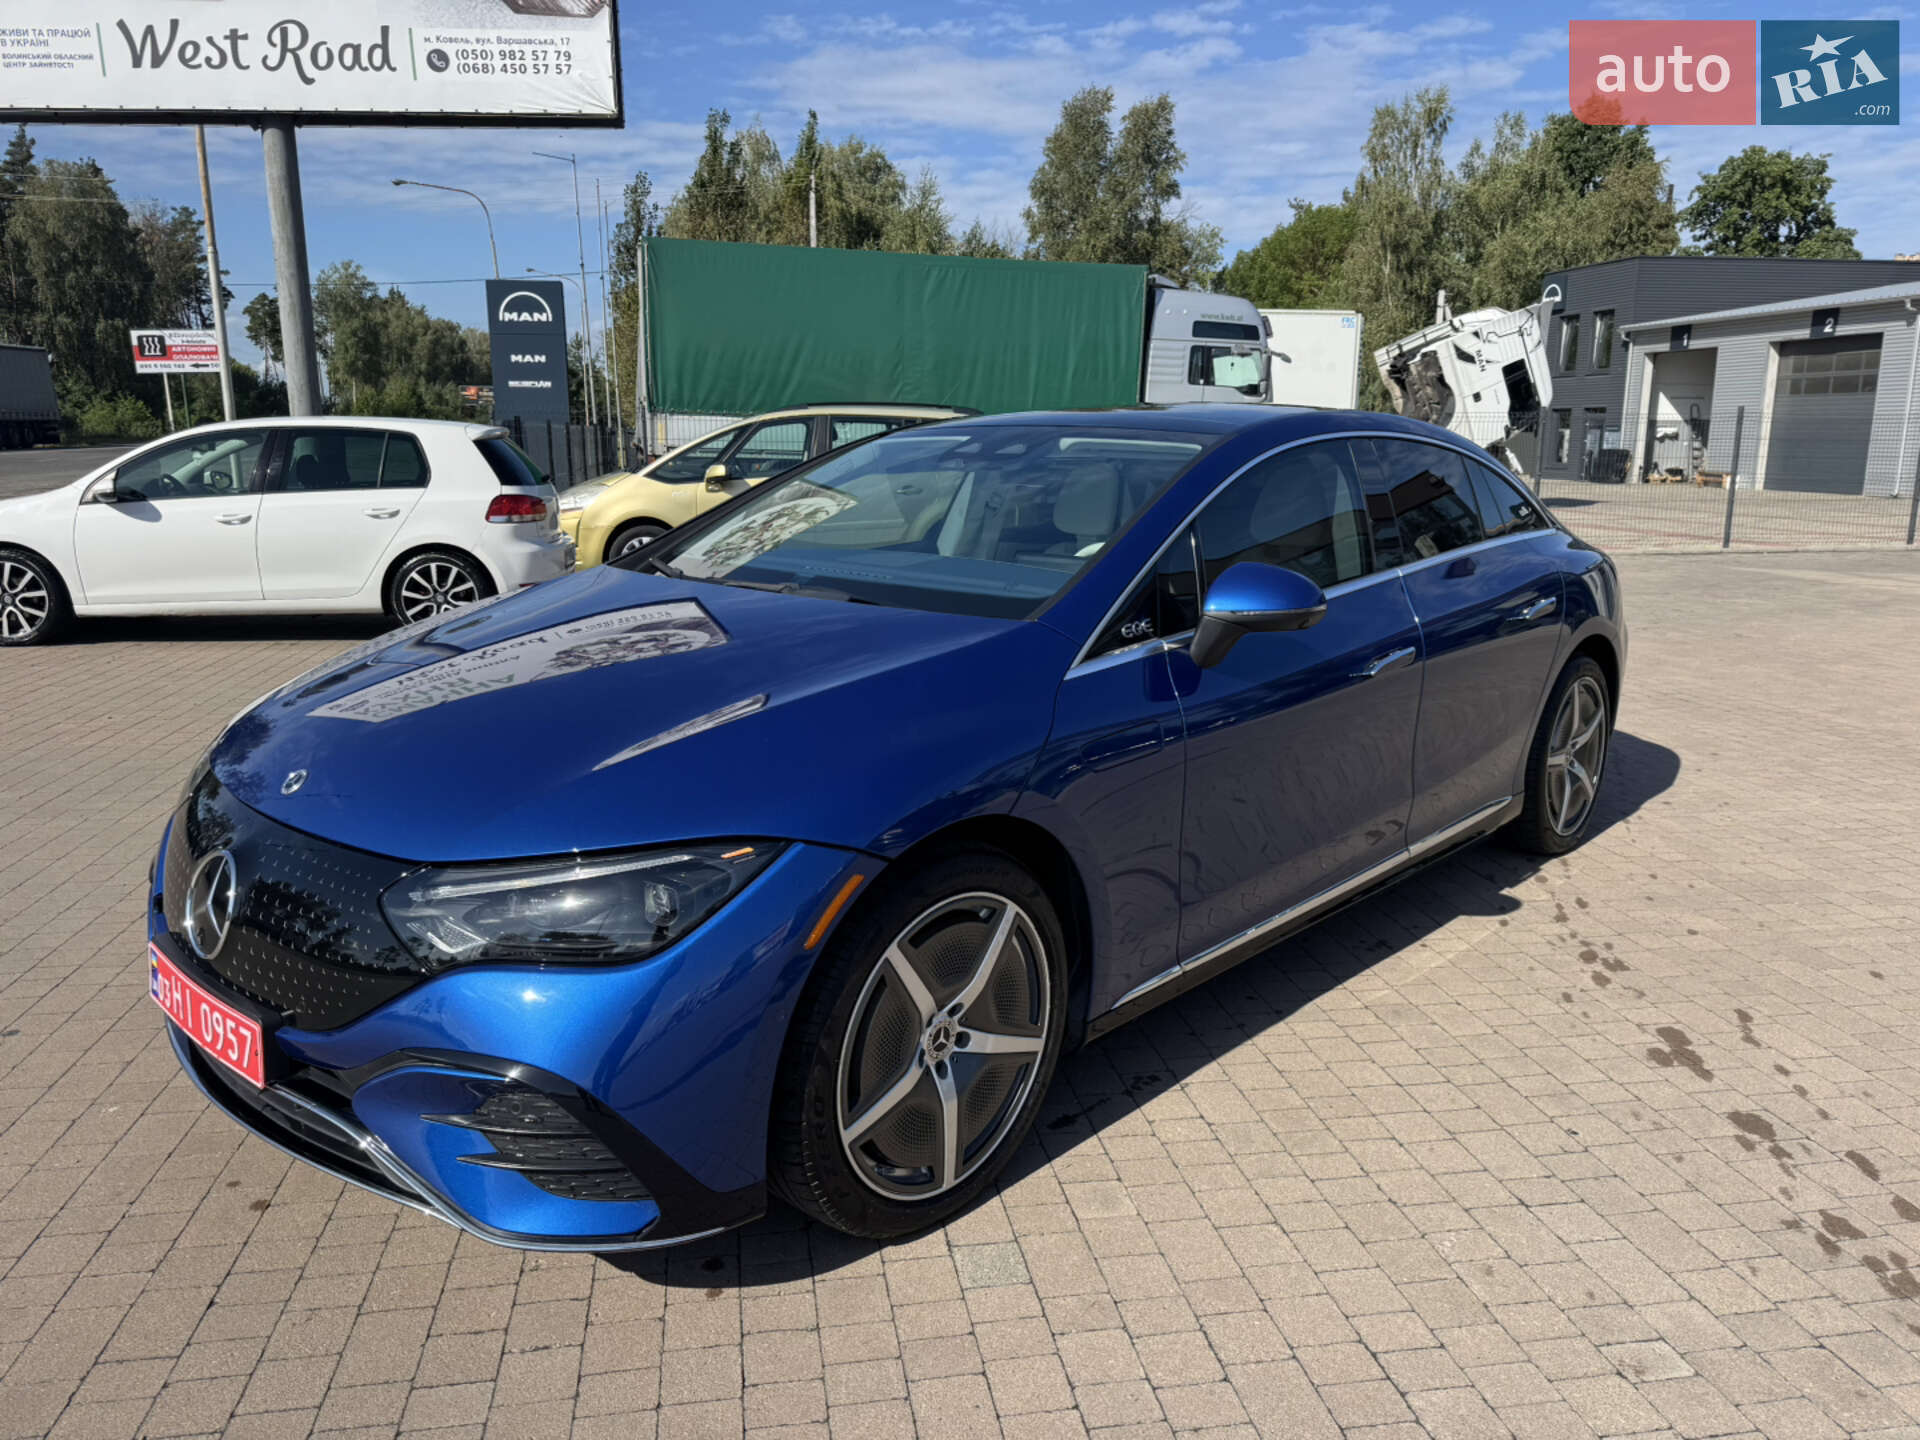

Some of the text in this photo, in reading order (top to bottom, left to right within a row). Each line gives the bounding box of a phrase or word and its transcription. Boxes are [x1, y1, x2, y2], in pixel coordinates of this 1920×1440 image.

[31, 28, 45, 37] ТА
[46, 27, 91, 38] ПРАЦЮЙ
[1, 38, 49, 47] В УКРАЇНІ
[560, 37, 570, 45] 17
[116, 18, 397, 86] West Road
[455, 49, 572, 62] (050) 982 57 79
[456, 62, 572, 75] (068) 450 57 57
[503, 311, 548, 322] MAN
[1823, 317, 1834, 333] 2
[1682, 333, 1689, 347] 1
[510, 353, 547, 363] MAN
[1121, 618, 1155, 639] EQE
[200, 1002, 252, 1069] 0957
